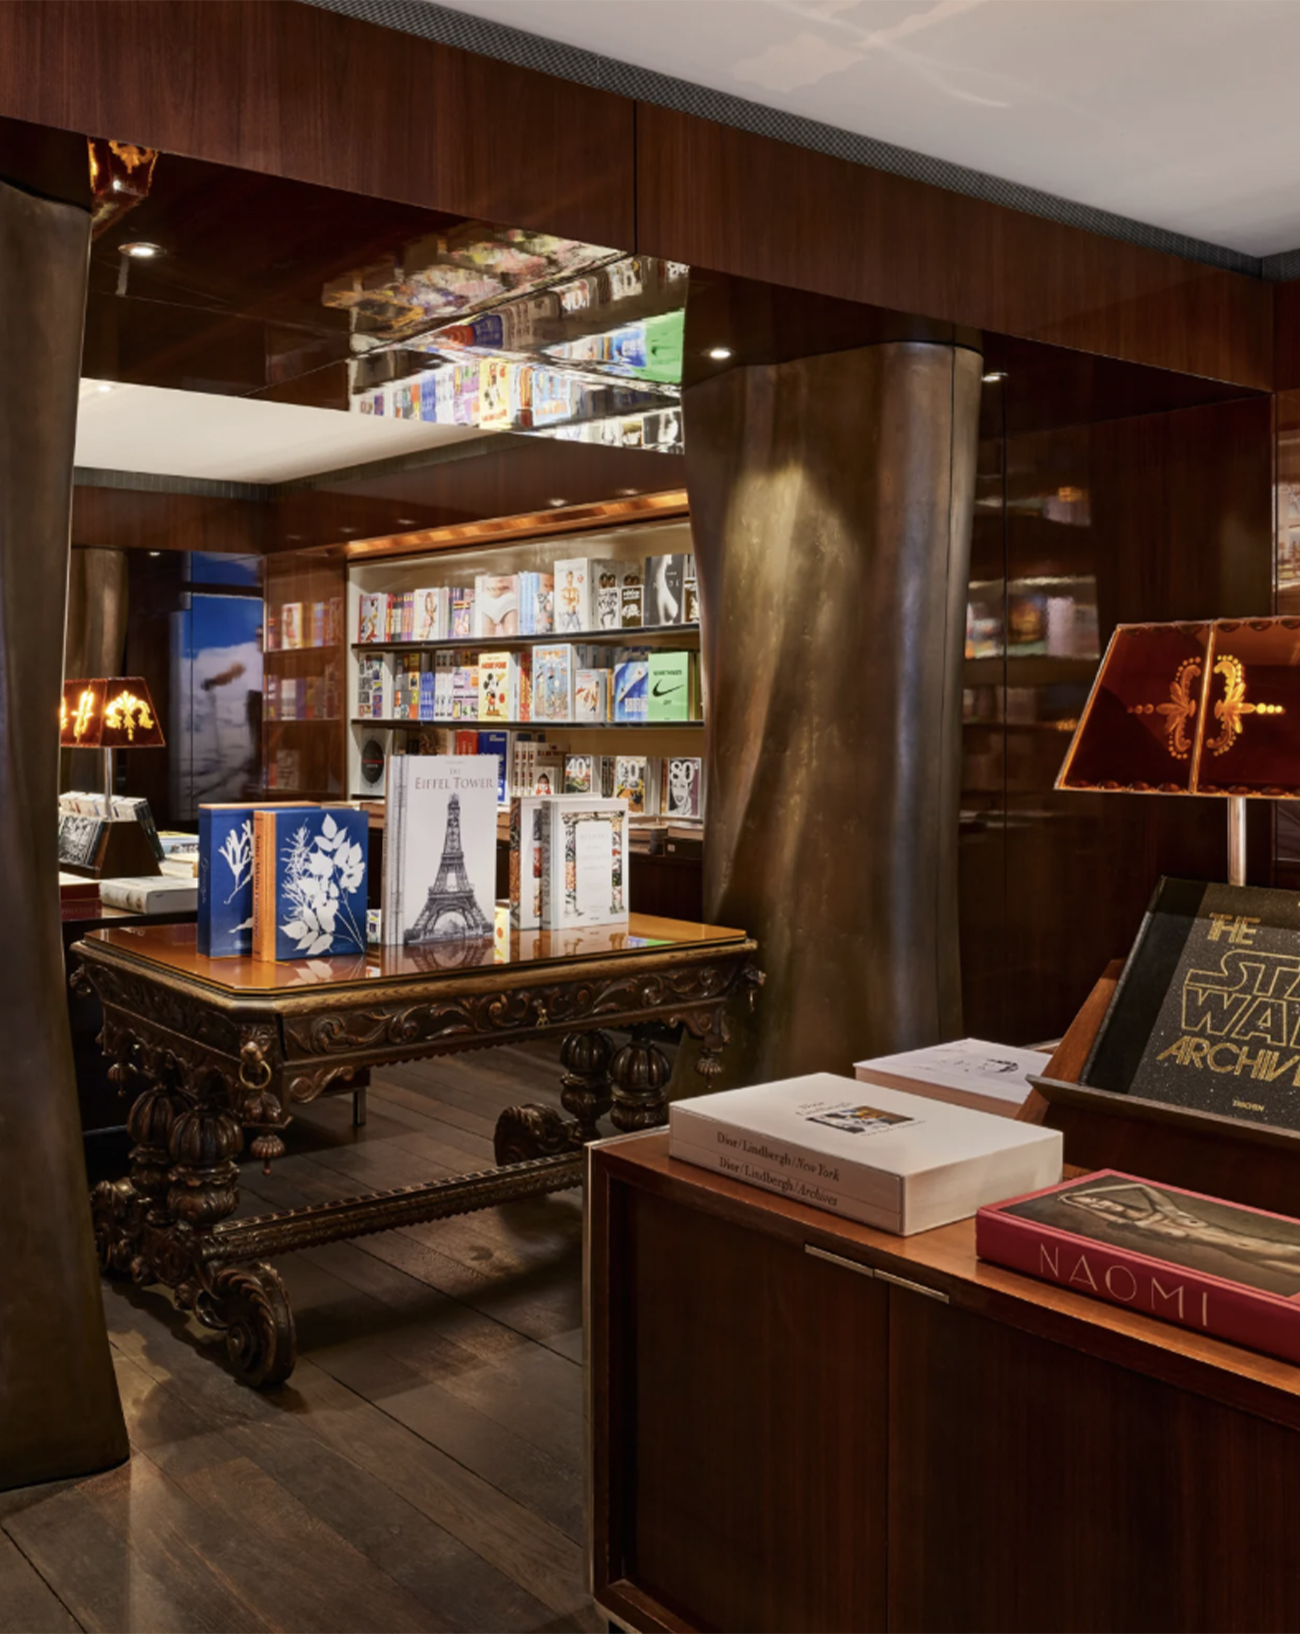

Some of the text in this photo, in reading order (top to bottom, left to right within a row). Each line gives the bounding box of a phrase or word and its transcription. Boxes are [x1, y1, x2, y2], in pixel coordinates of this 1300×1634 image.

[415, 776, 494, 790] EIFFEL TOWER
[1207, 912, 1261, 945] THE
[1181, 985, 1300, 1048] WA
[1040, 1243, 1208, 1327] NAOMI
